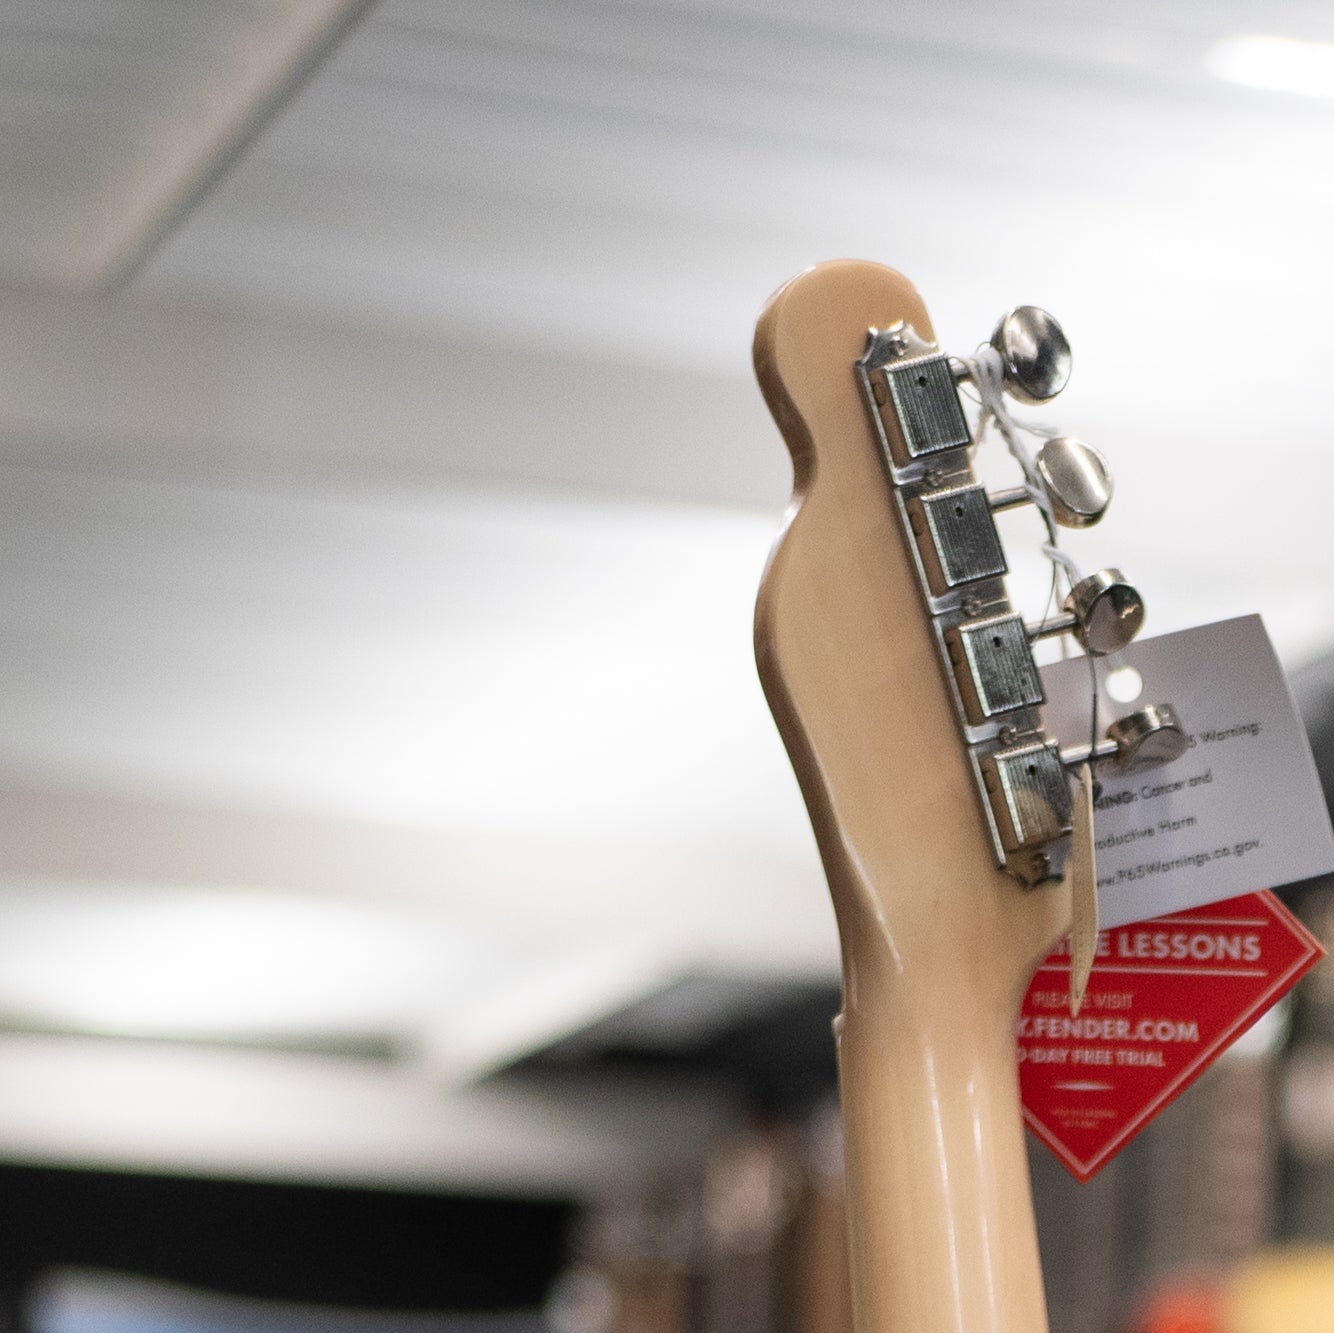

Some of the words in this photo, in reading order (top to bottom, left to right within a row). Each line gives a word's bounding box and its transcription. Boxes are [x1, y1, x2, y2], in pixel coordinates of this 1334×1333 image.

[1140, 780, 1185, 799] Cancer
[1188, 768, 1213, 788] and
[1094, 826, 1155, 851] roductive
[1157, 816, 1198, 834] Harm
[1117, 931, 1262, 963] LESSONS
[1032, 991, 1092, 1010] PLEAE
[1093, 992, 1134, 1010] VISIT
[1016, 1016, 1199, 1043] Y.FENDER.COM
[1017, 1046, 1070, 1065] 0-DAY
[1071, 1048, 1114, 1066] FREE
[1115, 1049, 1167, 1068] TRIAL
